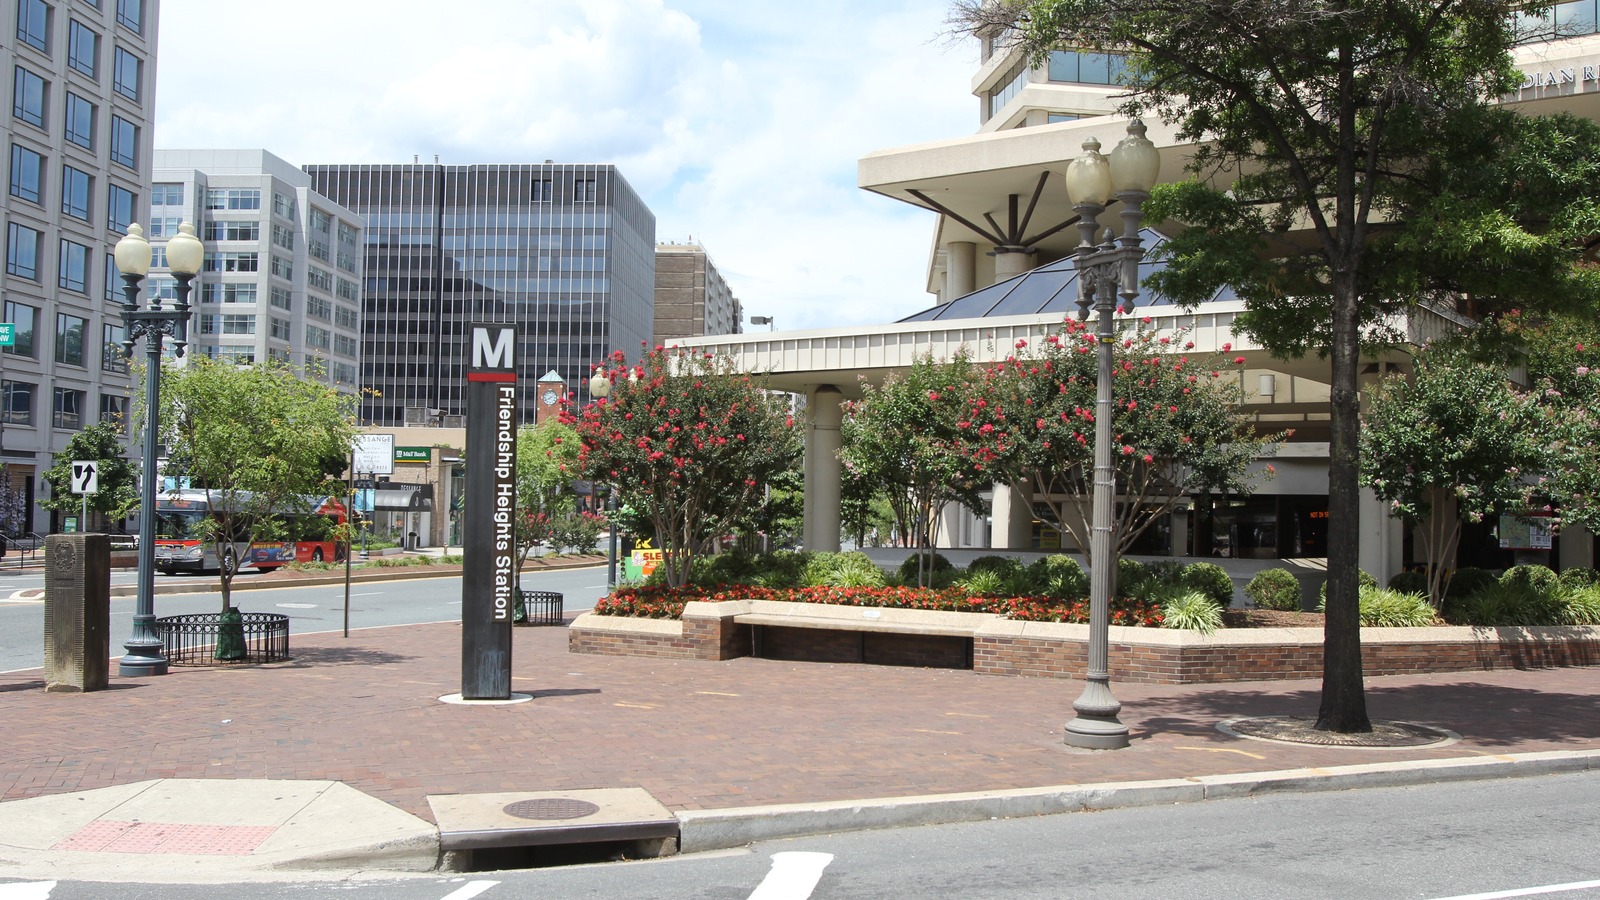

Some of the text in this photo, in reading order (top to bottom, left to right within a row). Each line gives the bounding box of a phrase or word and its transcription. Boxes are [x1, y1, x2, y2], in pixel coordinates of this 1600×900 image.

[1520, 67, 1574, 89] DIAN
[472, 327, 514, 369] M
[494, 387, 514, 619] Friendship Heights Station
[643, 552, 665, 560] SLE
